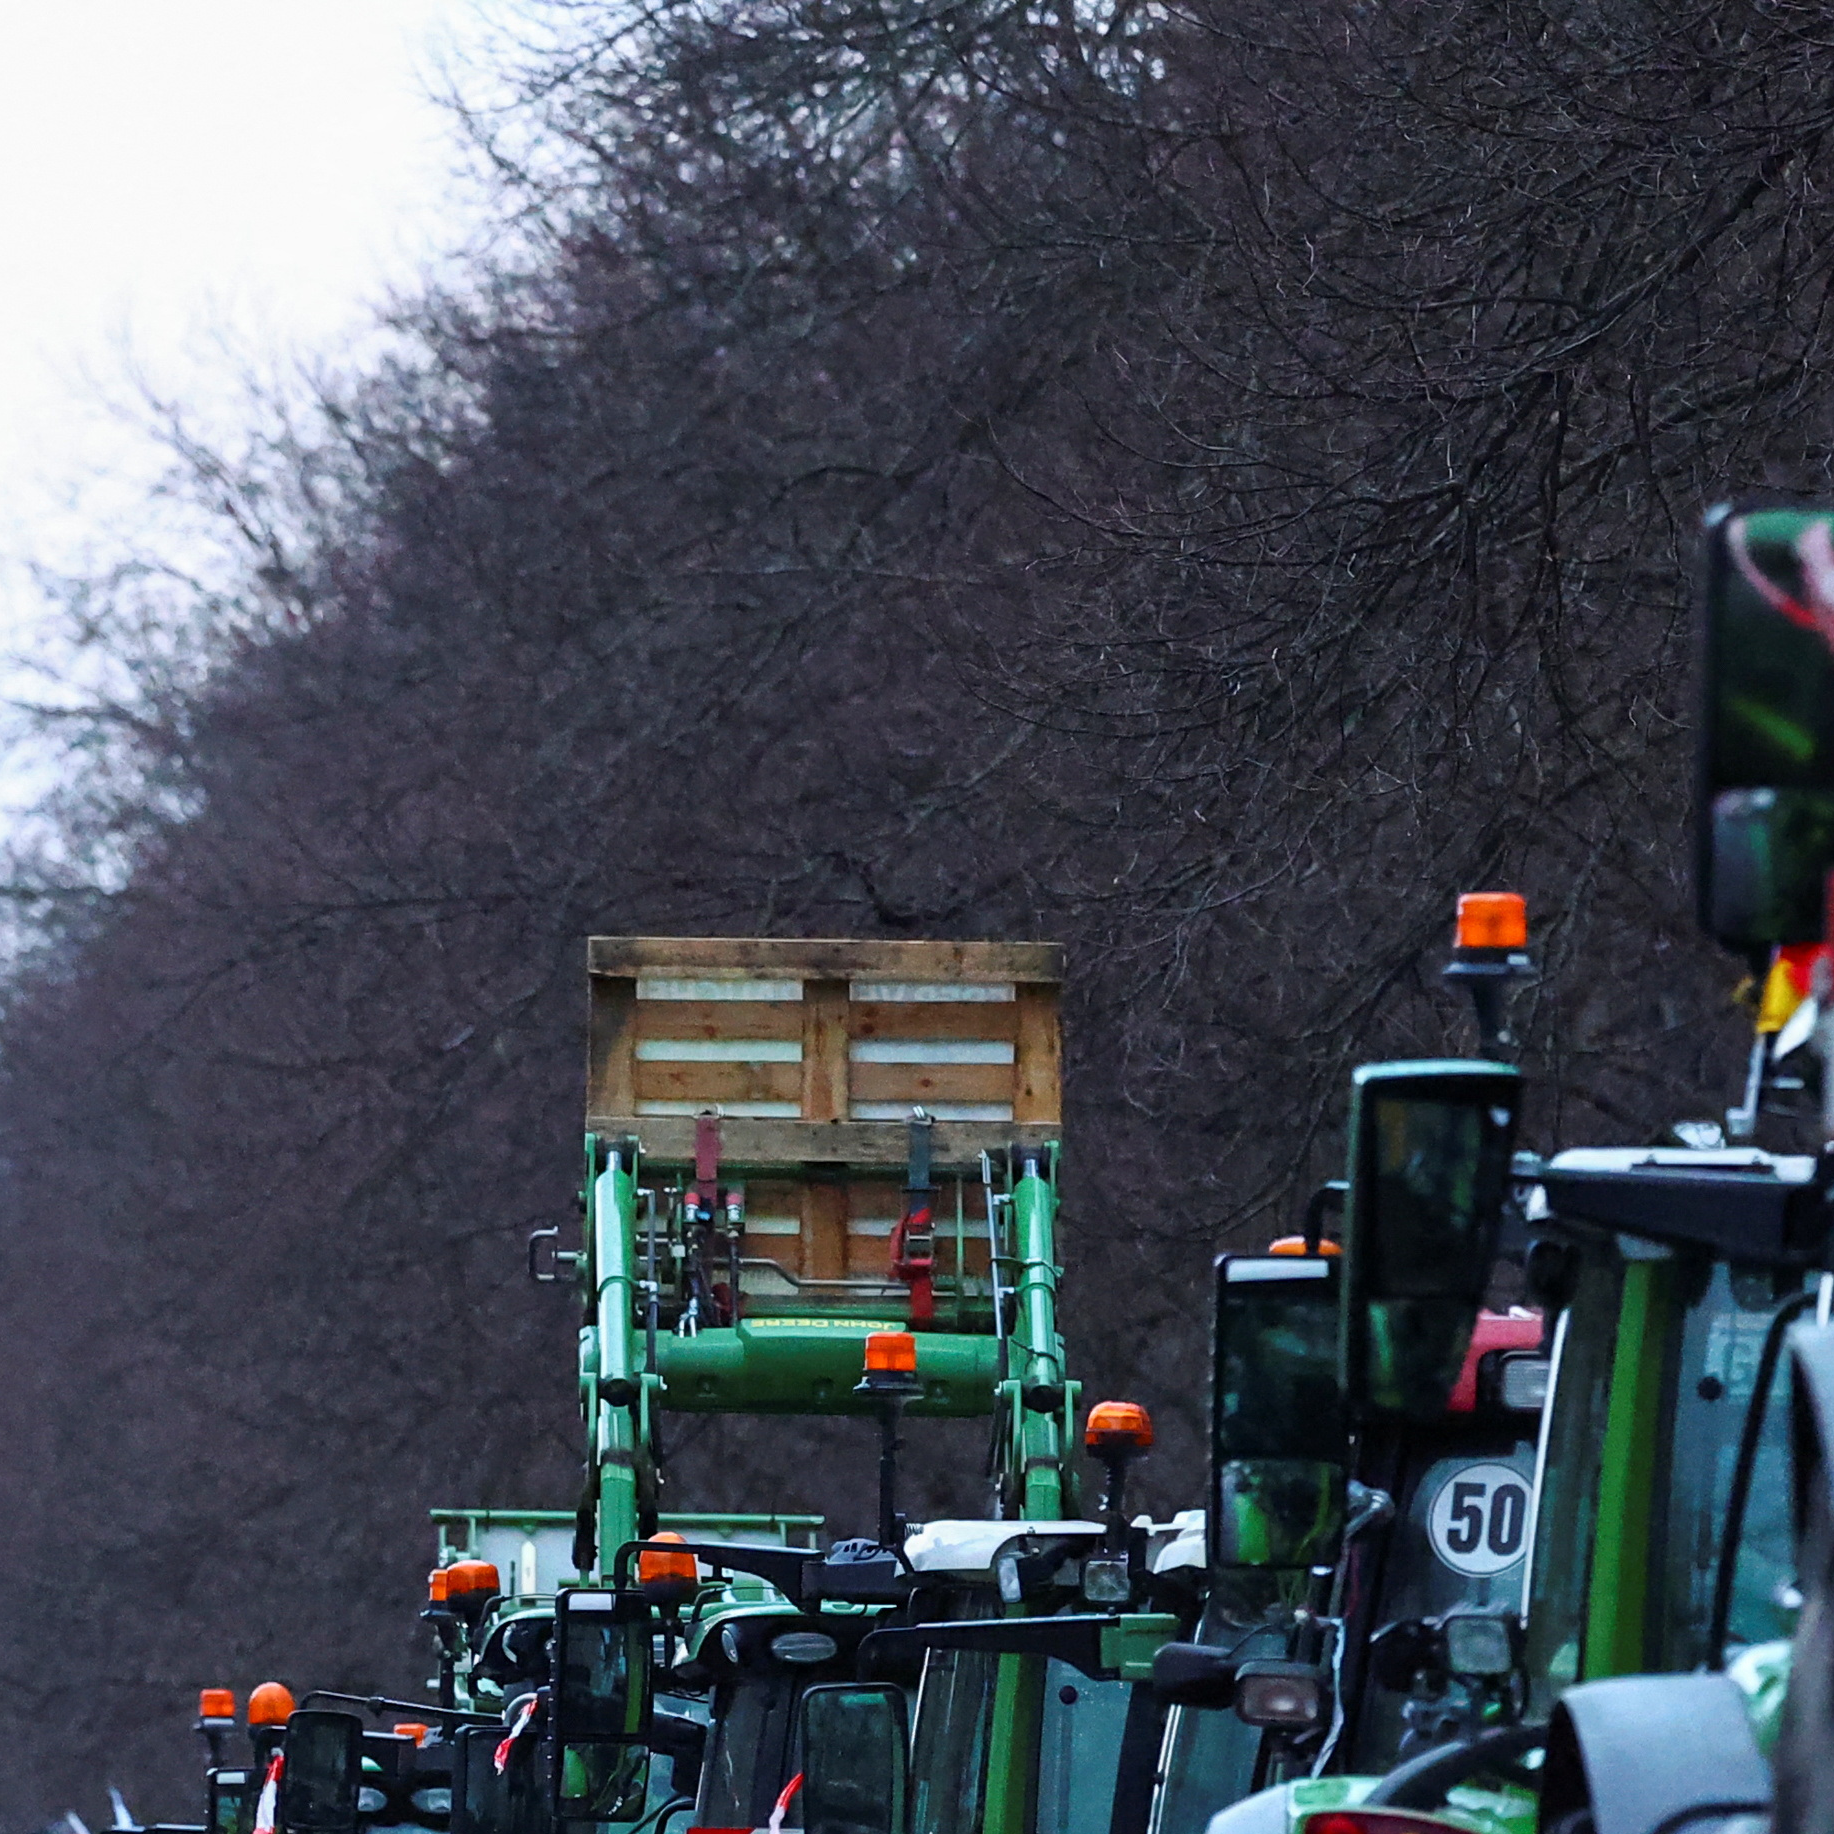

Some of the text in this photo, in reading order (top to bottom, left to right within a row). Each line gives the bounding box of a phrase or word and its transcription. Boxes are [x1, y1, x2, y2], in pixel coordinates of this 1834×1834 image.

[751, 1318, 896, 1330] JOHN DEERE
[1447, 1482, 1526, 1556] 50
